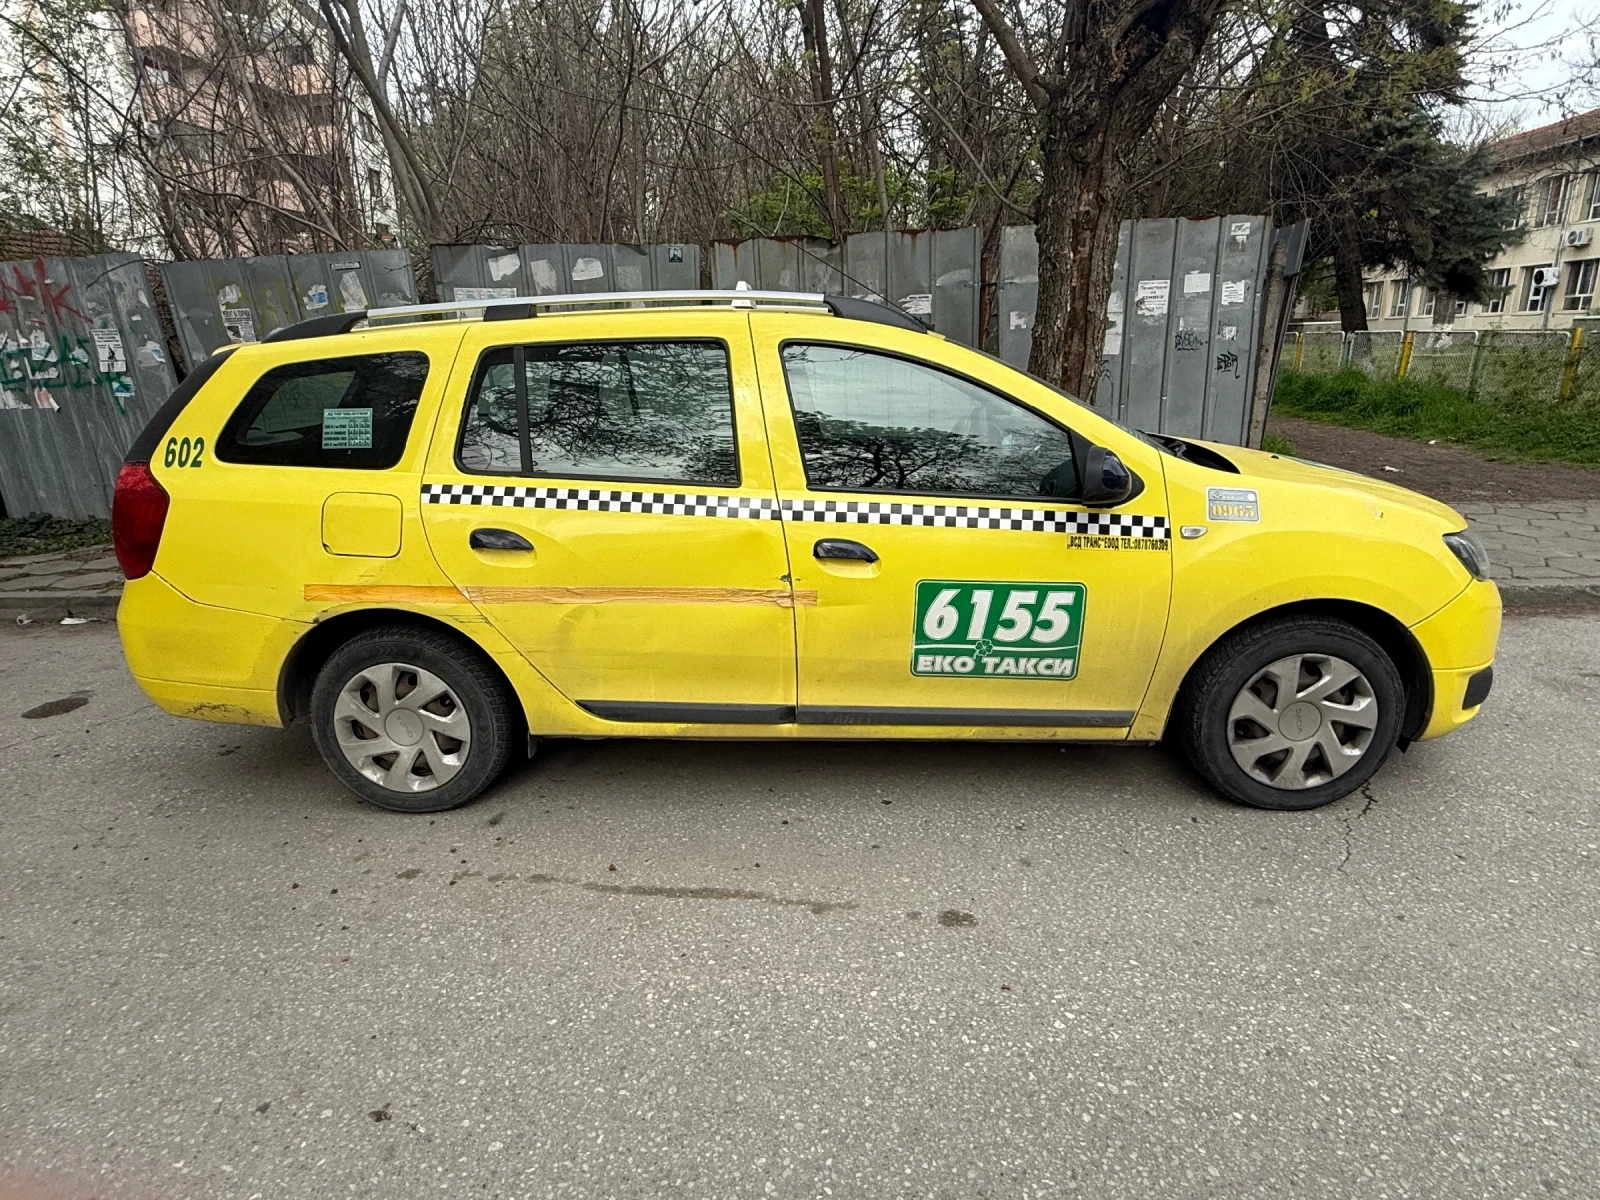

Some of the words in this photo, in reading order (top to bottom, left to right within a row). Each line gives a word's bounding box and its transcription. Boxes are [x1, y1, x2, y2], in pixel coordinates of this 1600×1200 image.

[164, 437, 205, 468] 602
[1212, 503, 1255, 518] 0965
[922, 588, 1074, 643] 6155
[916, 655, 975, 674] ЕКО
[982, 656, 1074, 676] ТАКСИ
